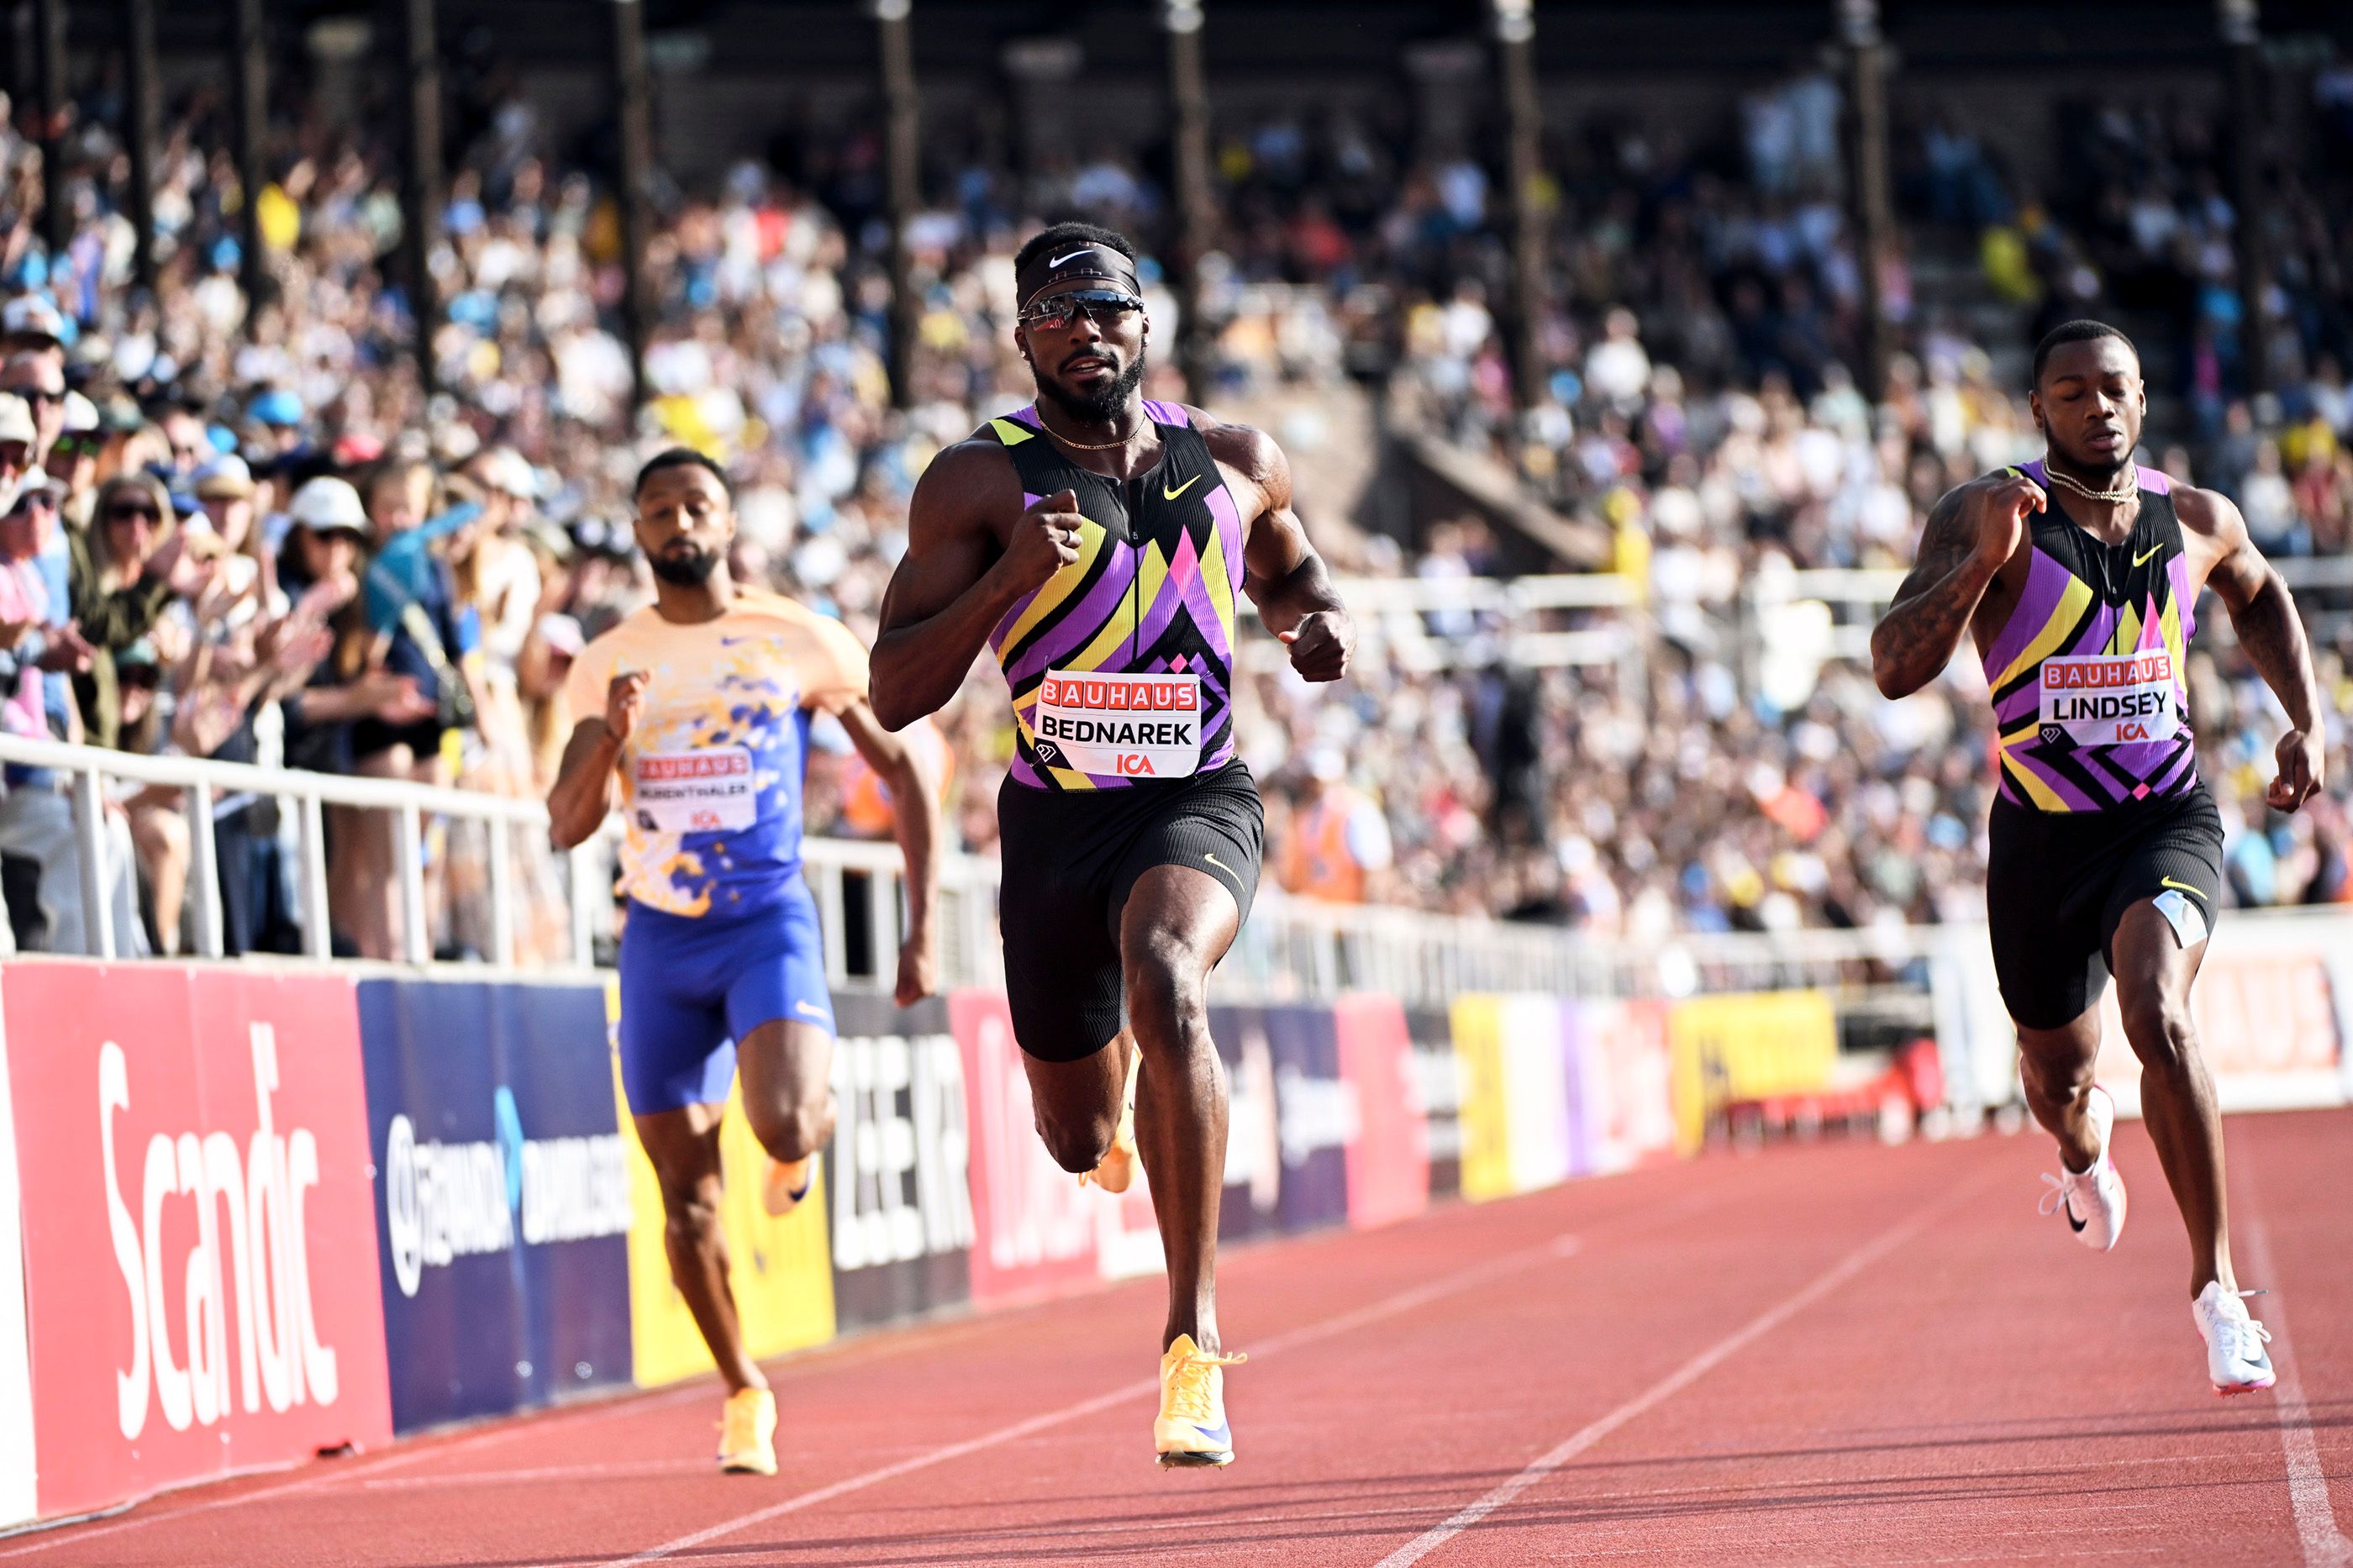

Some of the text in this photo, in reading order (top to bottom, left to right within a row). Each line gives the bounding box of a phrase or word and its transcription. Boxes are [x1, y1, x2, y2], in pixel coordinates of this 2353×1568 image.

[2046, 656, 2170, 687] BAUHAUS
[1042, 680, 1195, 708] BAUHAUS
[2053, 691, 2166, 720] LINDSEY
[1041, 714, 1192, 745] BEDNAREK
[2116, 723, 2149, 742] ICA
[1116, 754, 1155, 775] ICA
[98, 1021, 338, 1441] Scandic
